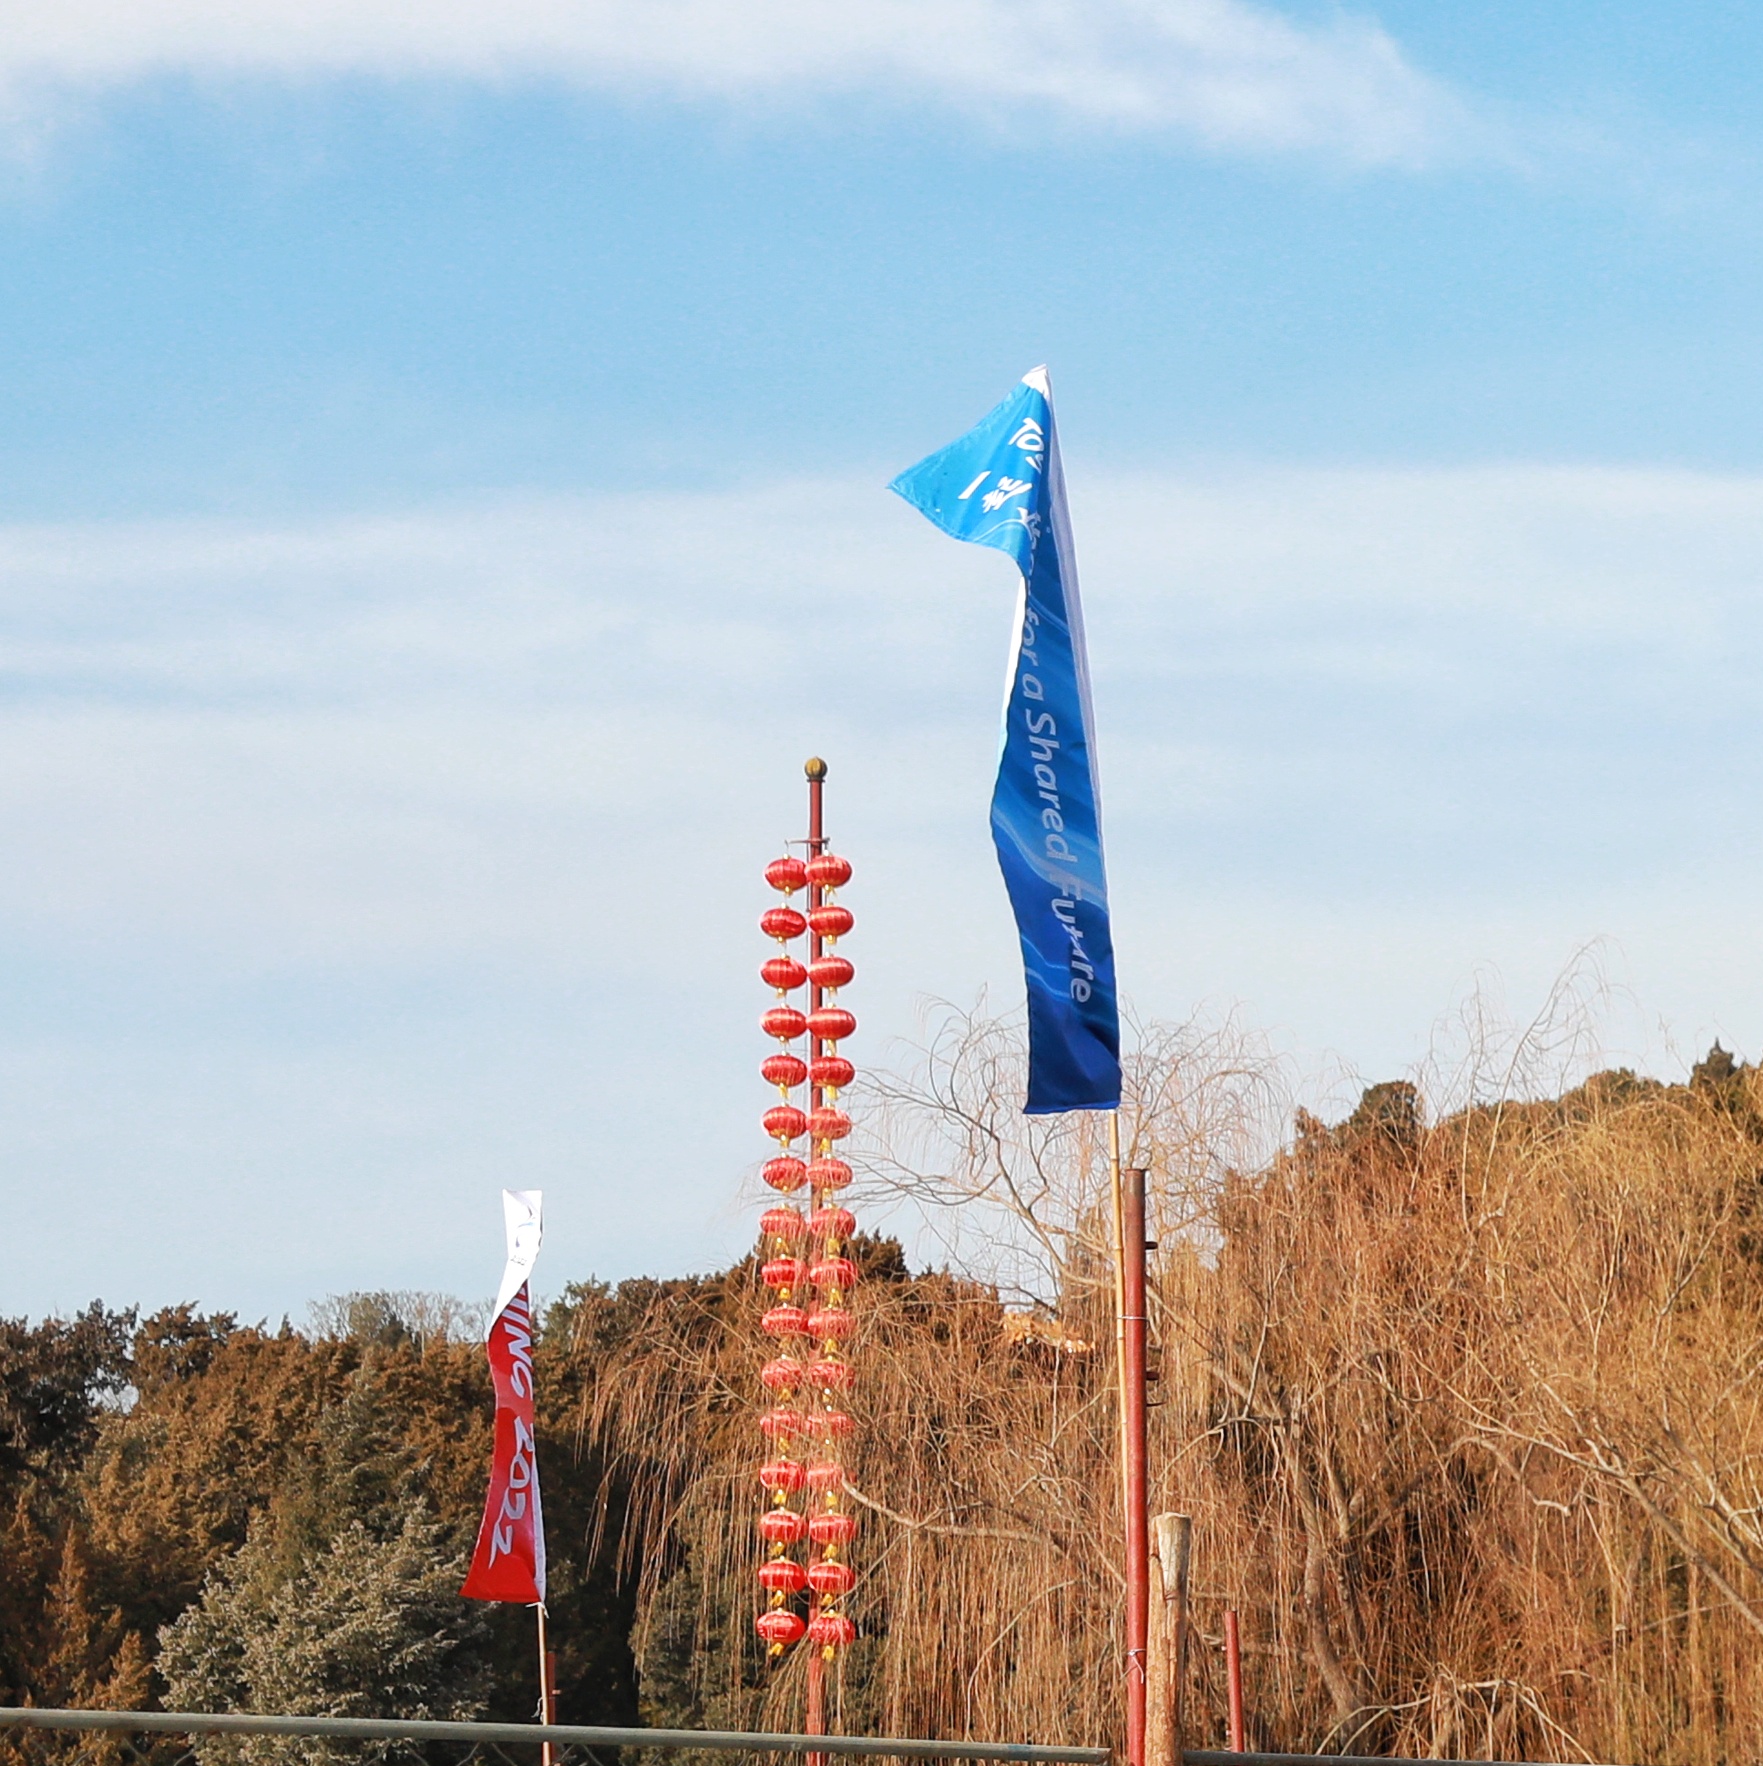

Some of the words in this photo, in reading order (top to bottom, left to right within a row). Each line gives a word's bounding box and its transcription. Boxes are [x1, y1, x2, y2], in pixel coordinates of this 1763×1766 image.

[1021, 672, 1045, 702] a
[1024, 707, 1079, 864] Shared
[1050, 872, 1095, 1004] Future
[488, 1415, 537, 1571] 2022
